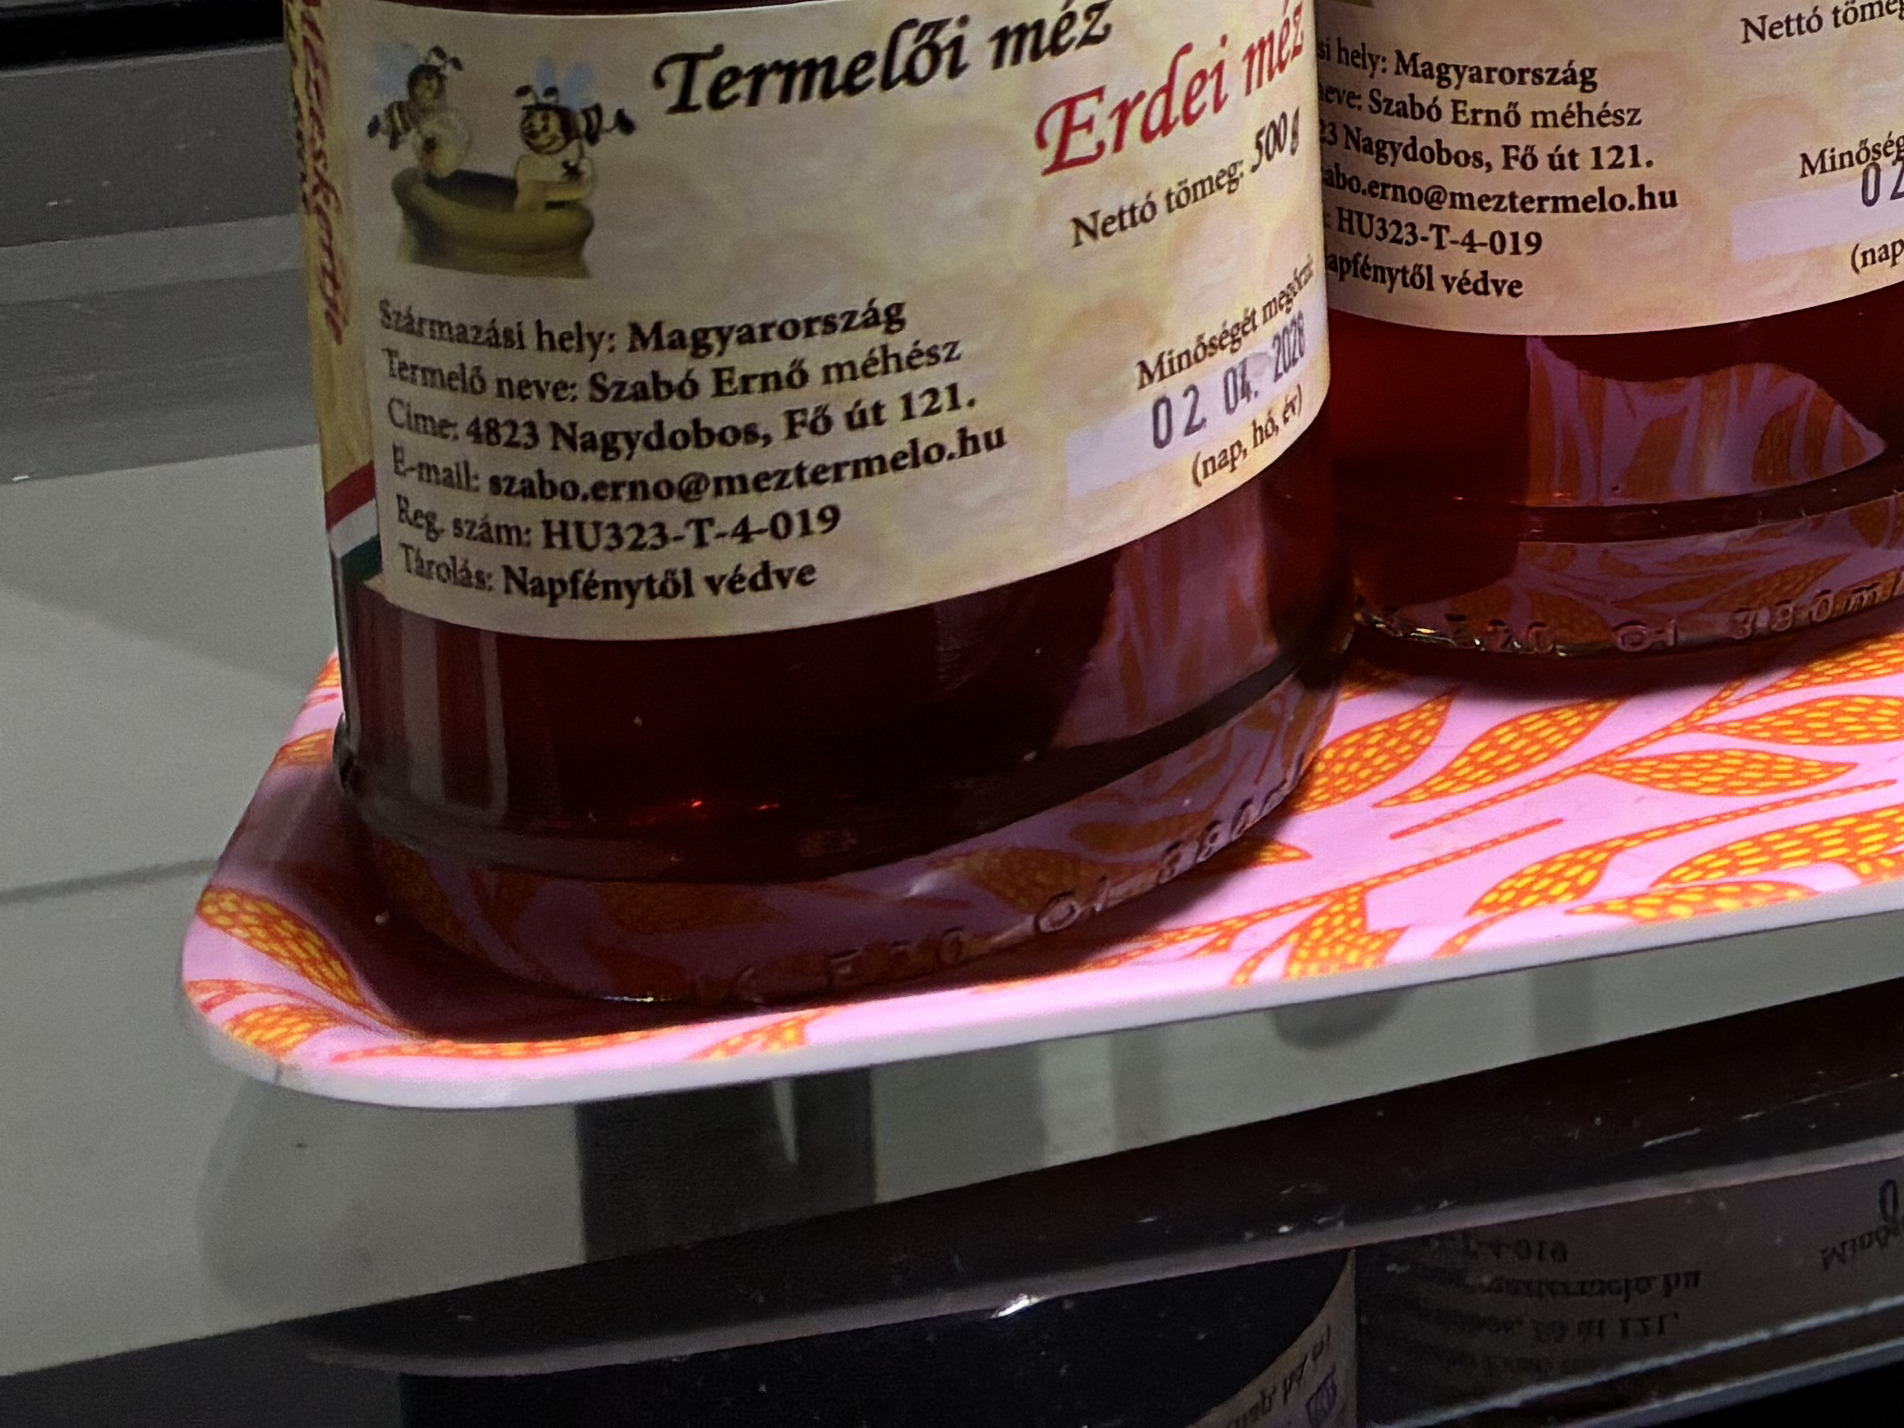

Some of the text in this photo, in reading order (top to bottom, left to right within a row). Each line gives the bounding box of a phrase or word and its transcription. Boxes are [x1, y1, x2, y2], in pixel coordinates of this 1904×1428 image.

[1740, 5, 1824, 45] Nettó
[653, 13, 972, 115] Termelői
[1336, 42, 1387, 79] hely:
[1394, 48, 1598, 93] Magyarország
[1033, 33, 1230, 177] Erdei
[1368, 87, 1443, 123] Szabó
[1450, 98, 1522, 129] Ernő
[1530, 100, 1643, 129] méhész
[1071, 190, 1158, 248] Nettó
[1164, 159, 1245, 214] tömeg:
[1250, 111, 1288, 174] 500
[1344, 124, 1493, 174] Nagydobos,
[1501, 142, 1539, 171] Fő
[1547, 144, 1581, 171] út
[1589, 144, 1655, 171] 121.
[1321, 162, 1679, 214] abo.erno@meztermelo.hu
[1336, 206, 1543, 257] HU323-T-4-019
[1326, 251, 1524, 299] apfénytől védve
[378, 296, 907, 363] Származási hely: Magyarország
[1136, 307, 1259, 392] Minőségét
[381, 338, 963, 404] Termelő neve: Szabó Ernő méhész
[465, 415, 540, 450] 4823
[550, 417, 773, 462] Nagydobos,
[783, 407, 834, 441] Fő
[844, 398, 887, 431] út
[900, 381, 976, 422] 121.
[391, 424, 1008, 504] E-mail: szabo.erno@meztermelo.hu
[1191, 438, 1249, 488] (nap,
[396, 493, 841, 552] Reg. szám: HU323-T-4-019
[400, 542, 817, 610] Tárolás: Napfénytől védve
